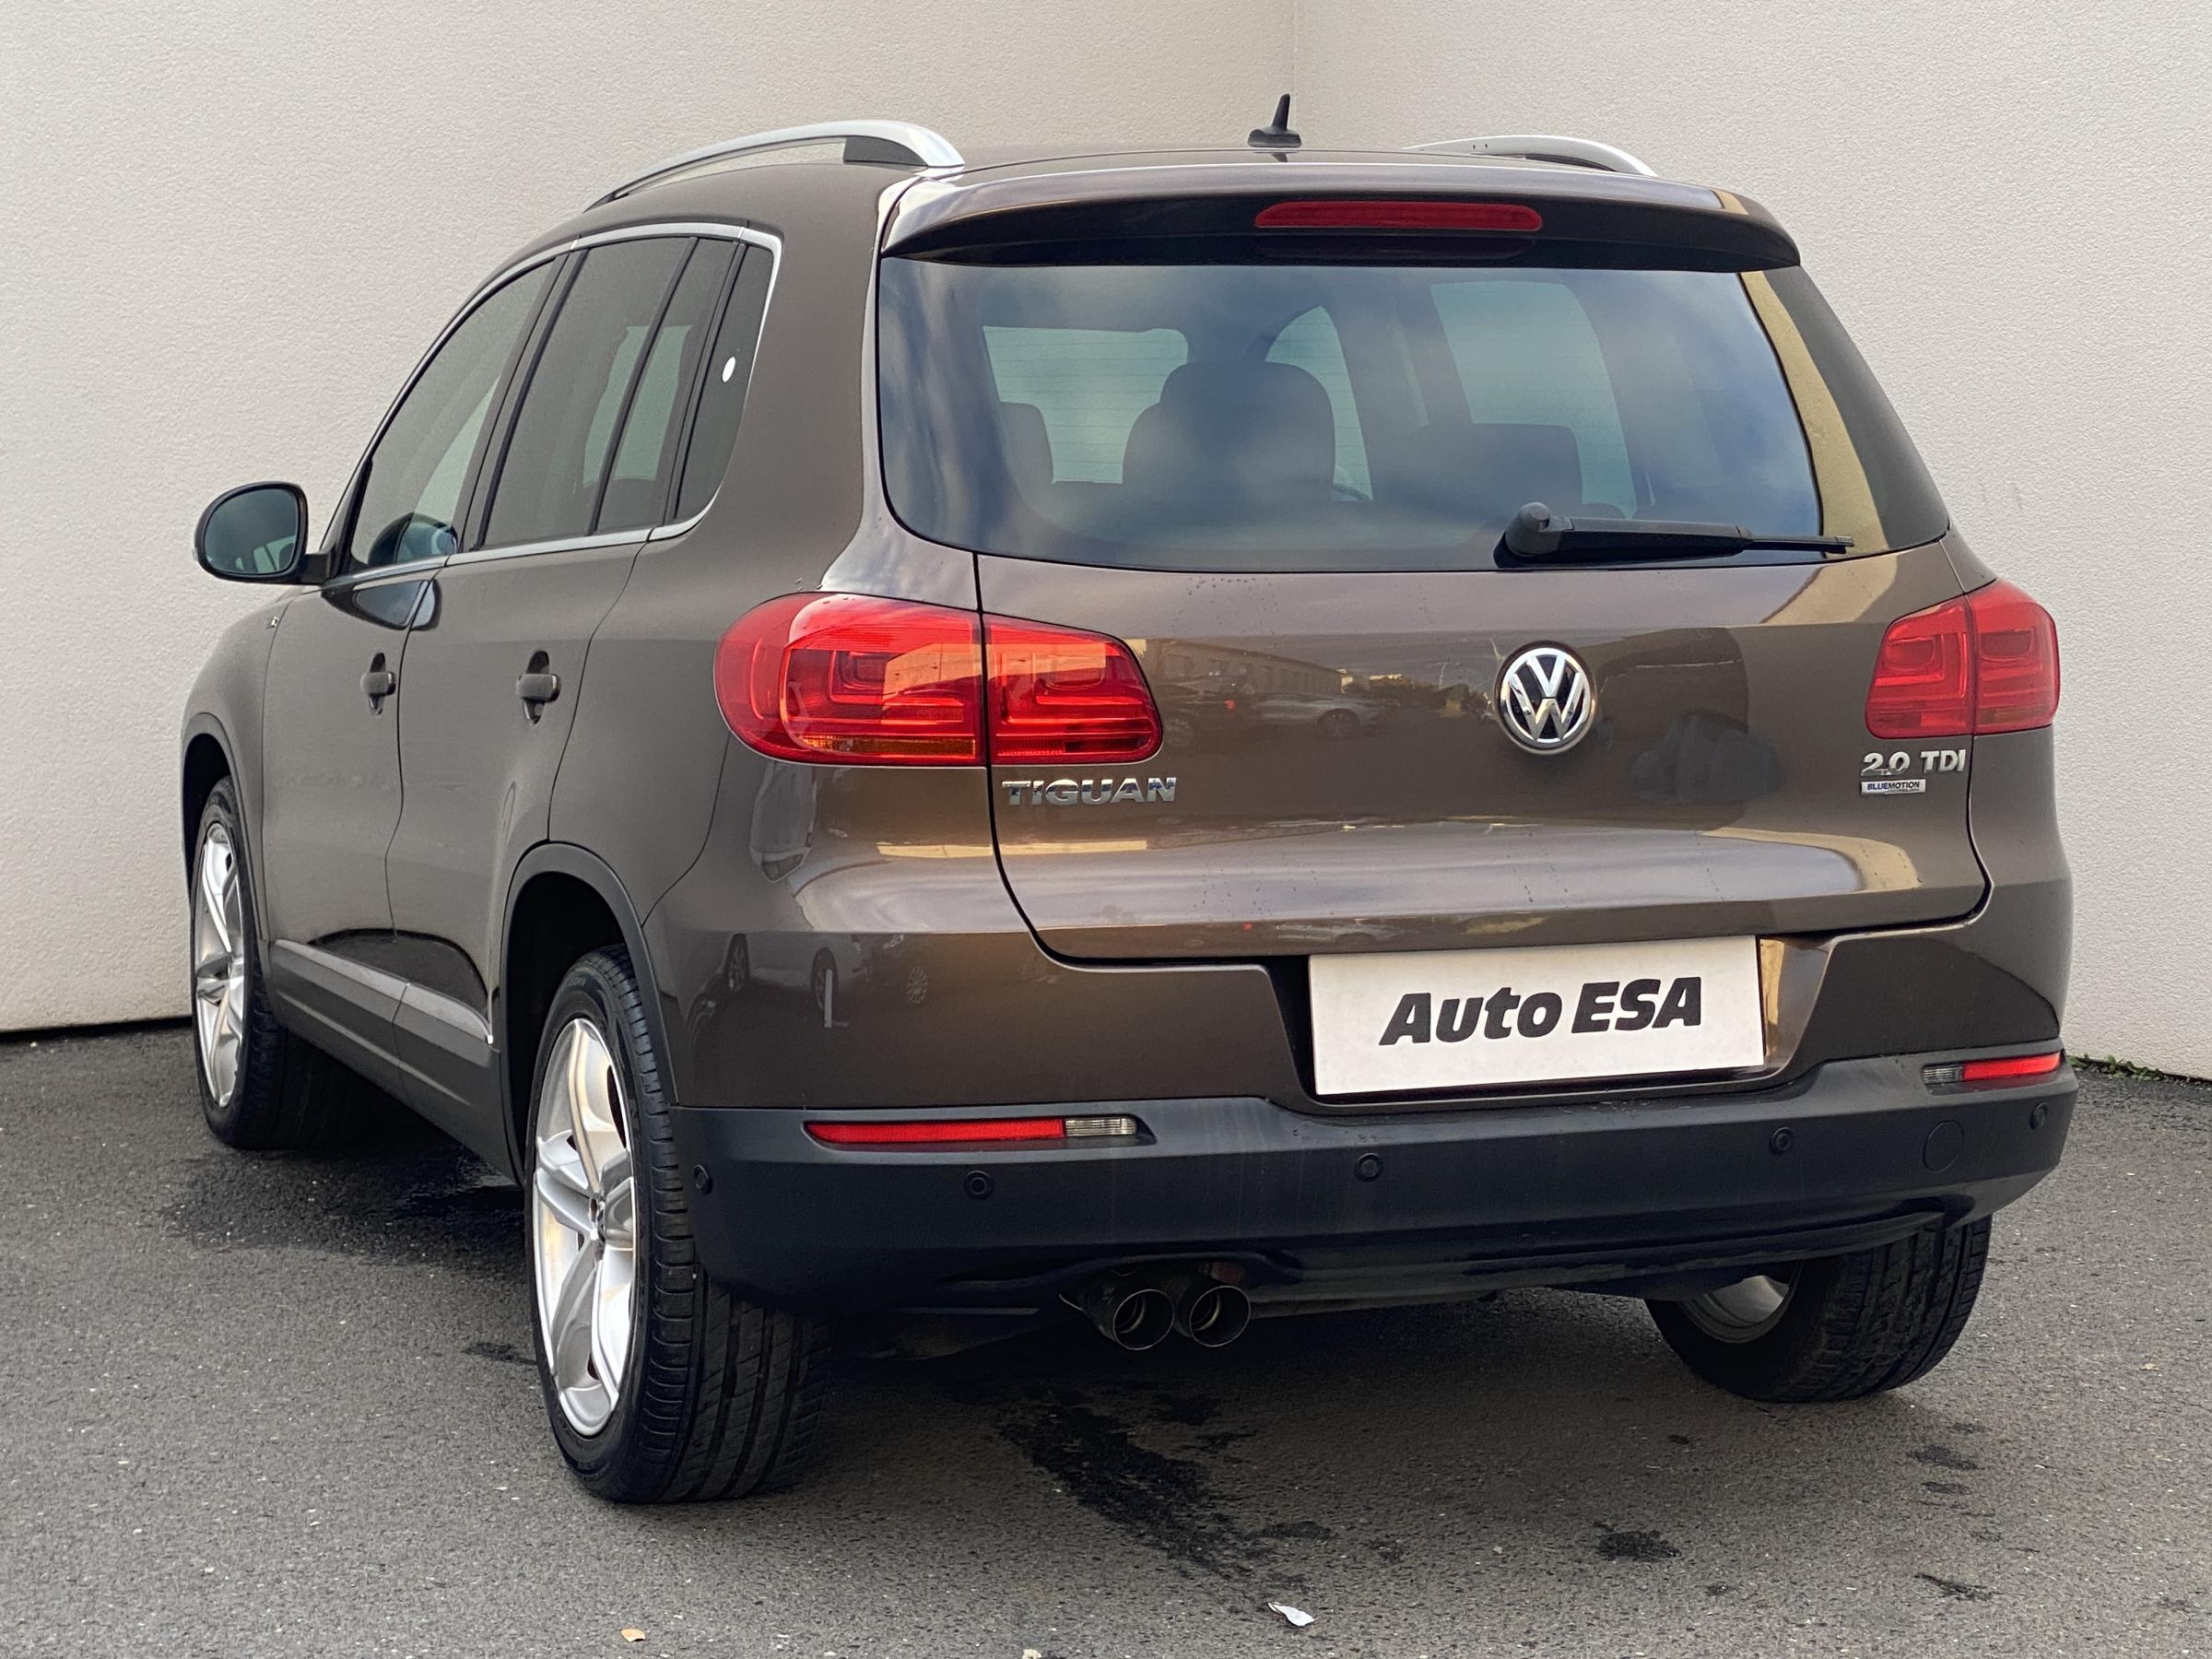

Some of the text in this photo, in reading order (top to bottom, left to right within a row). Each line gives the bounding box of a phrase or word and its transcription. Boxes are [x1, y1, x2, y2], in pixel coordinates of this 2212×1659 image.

[1920, 748, 1967, 773] TDI
[1001, 777, 1177, 806] TIGUAN
[1867, 781, 1920, 791] BLUEMOTION
[1378, 977, 1701, 1046] Auto ESA
